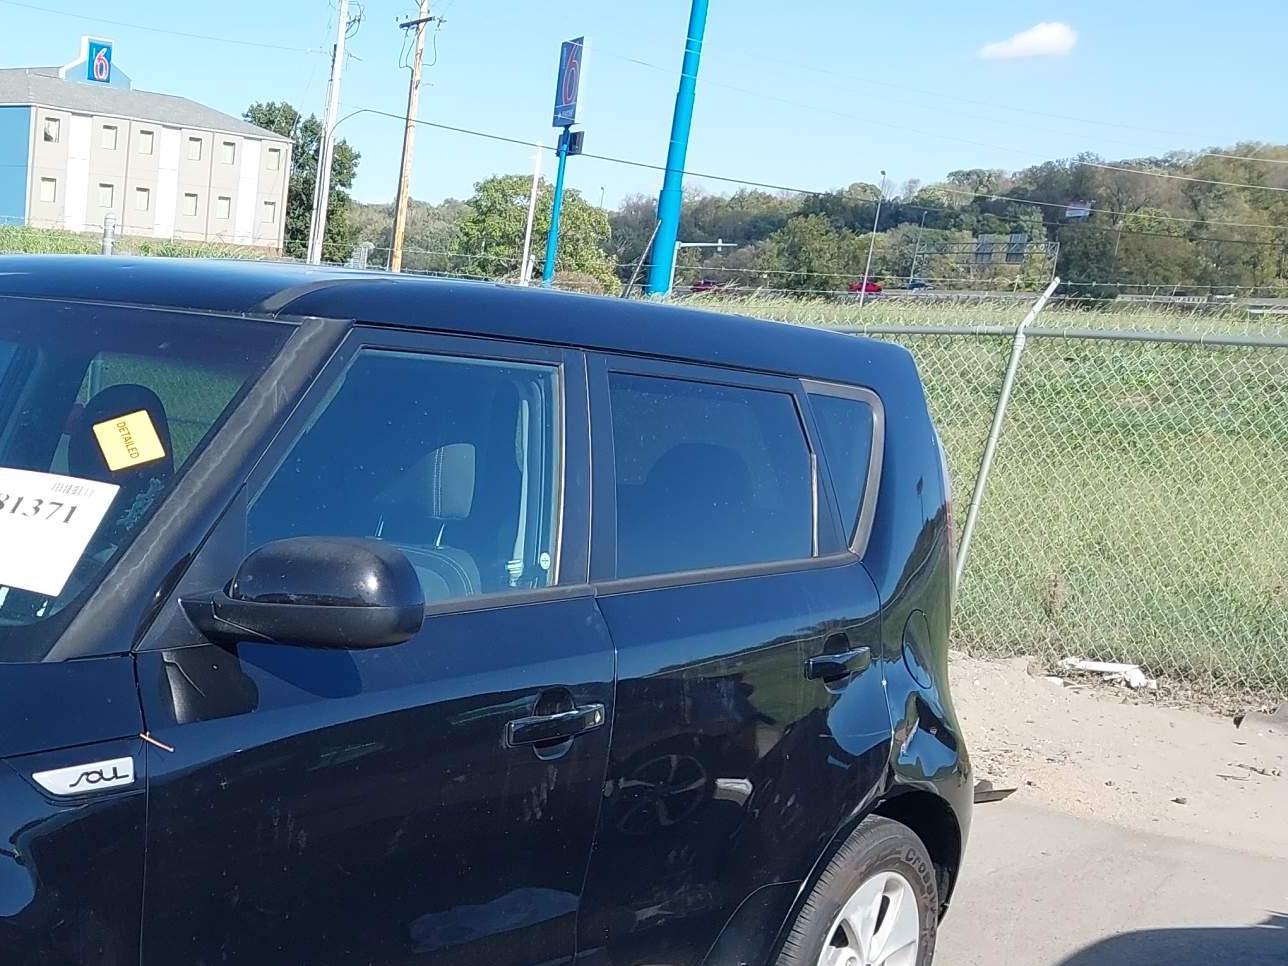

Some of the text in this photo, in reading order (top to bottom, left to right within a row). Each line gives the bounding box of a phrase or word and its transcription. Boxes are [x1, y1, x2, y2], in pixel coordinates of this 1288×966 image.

[94, 47, 109, 81] 6
[563, 43, 579, 105] 6
[116, 421, 140, 459] DETAILED
